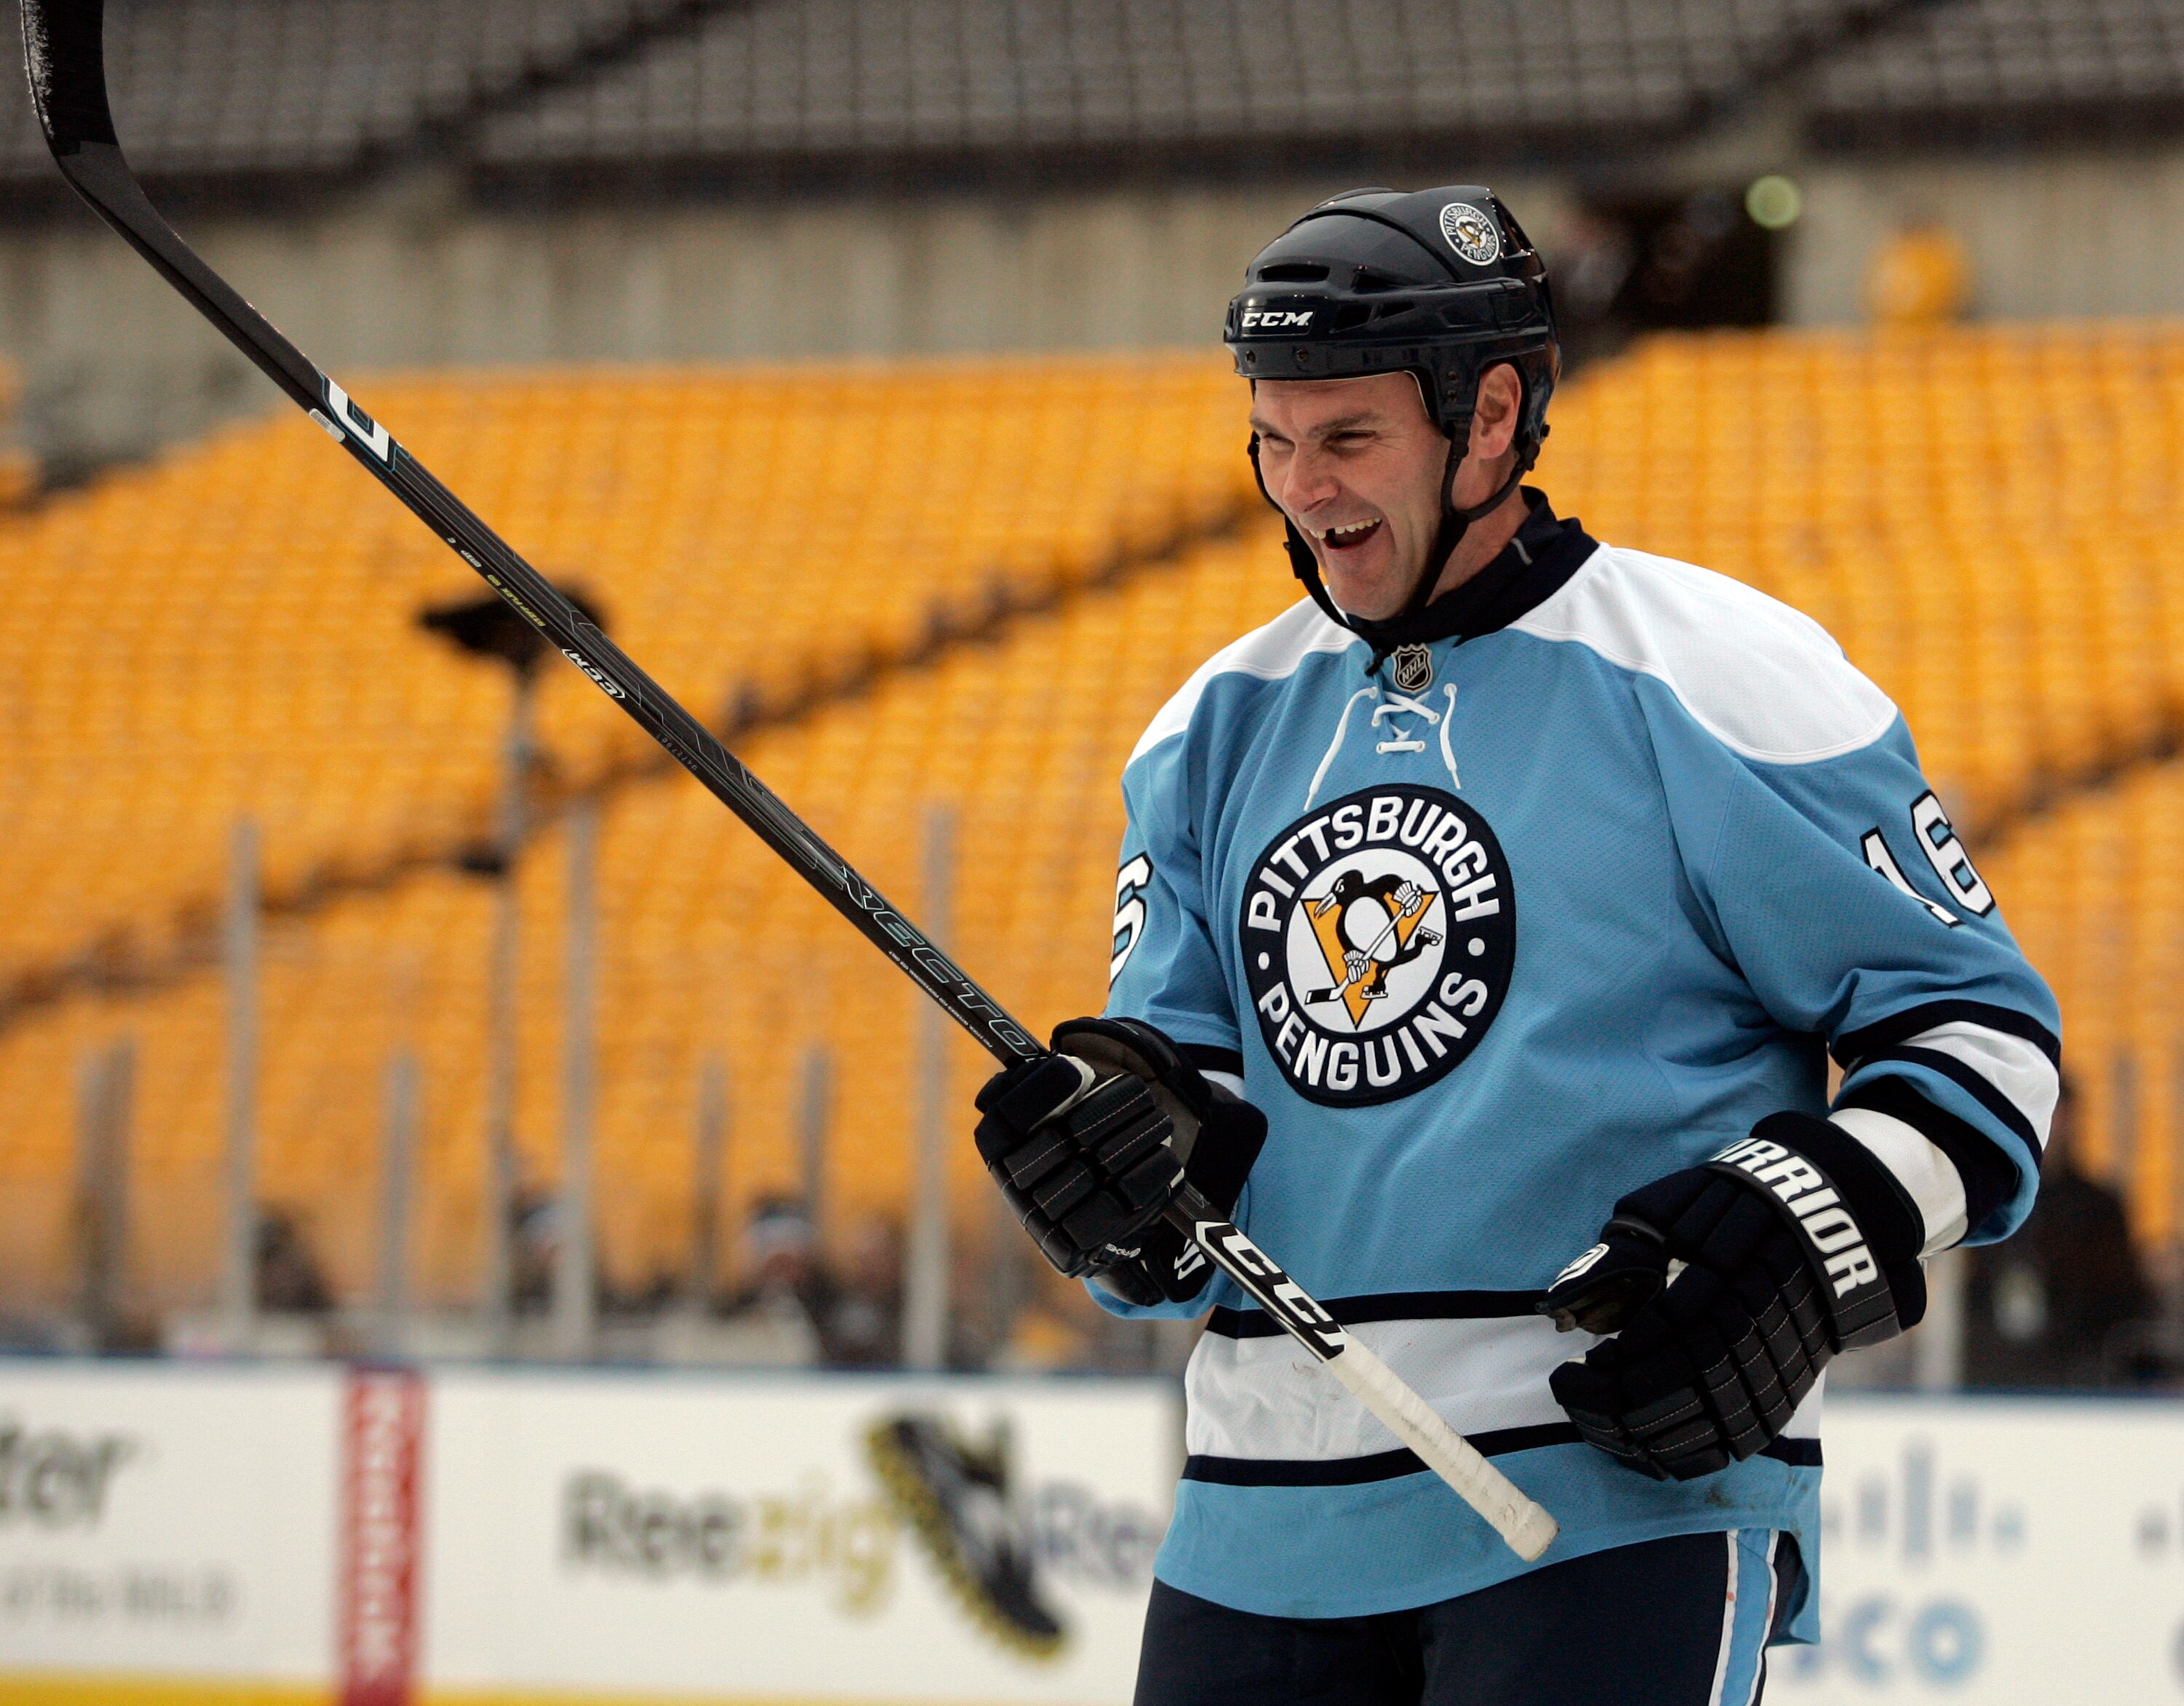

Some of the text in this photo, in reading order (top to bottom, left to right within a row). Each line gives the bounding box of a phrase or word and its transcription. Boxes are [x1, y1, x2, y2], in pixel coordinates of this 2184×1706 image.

[1444, 207, 1487, 235] PITTSBURGH
[1461, 234, 1495, 260] PENGUINS
[1242, 312, 1313, 327] CCM
[569, 652, 619, 697] CCM
[1401, 656, 1425, 683] NHL
[1248, 796, 1500, 932] PITTSBURGH
[1859, 789, 1996, 928] 16
[842, 865, 1044, 1060] VECTO
[1259, 972, 1488, 1091] PENGUINS
[1707, 1138, 1878, 1299] ARRIOR
